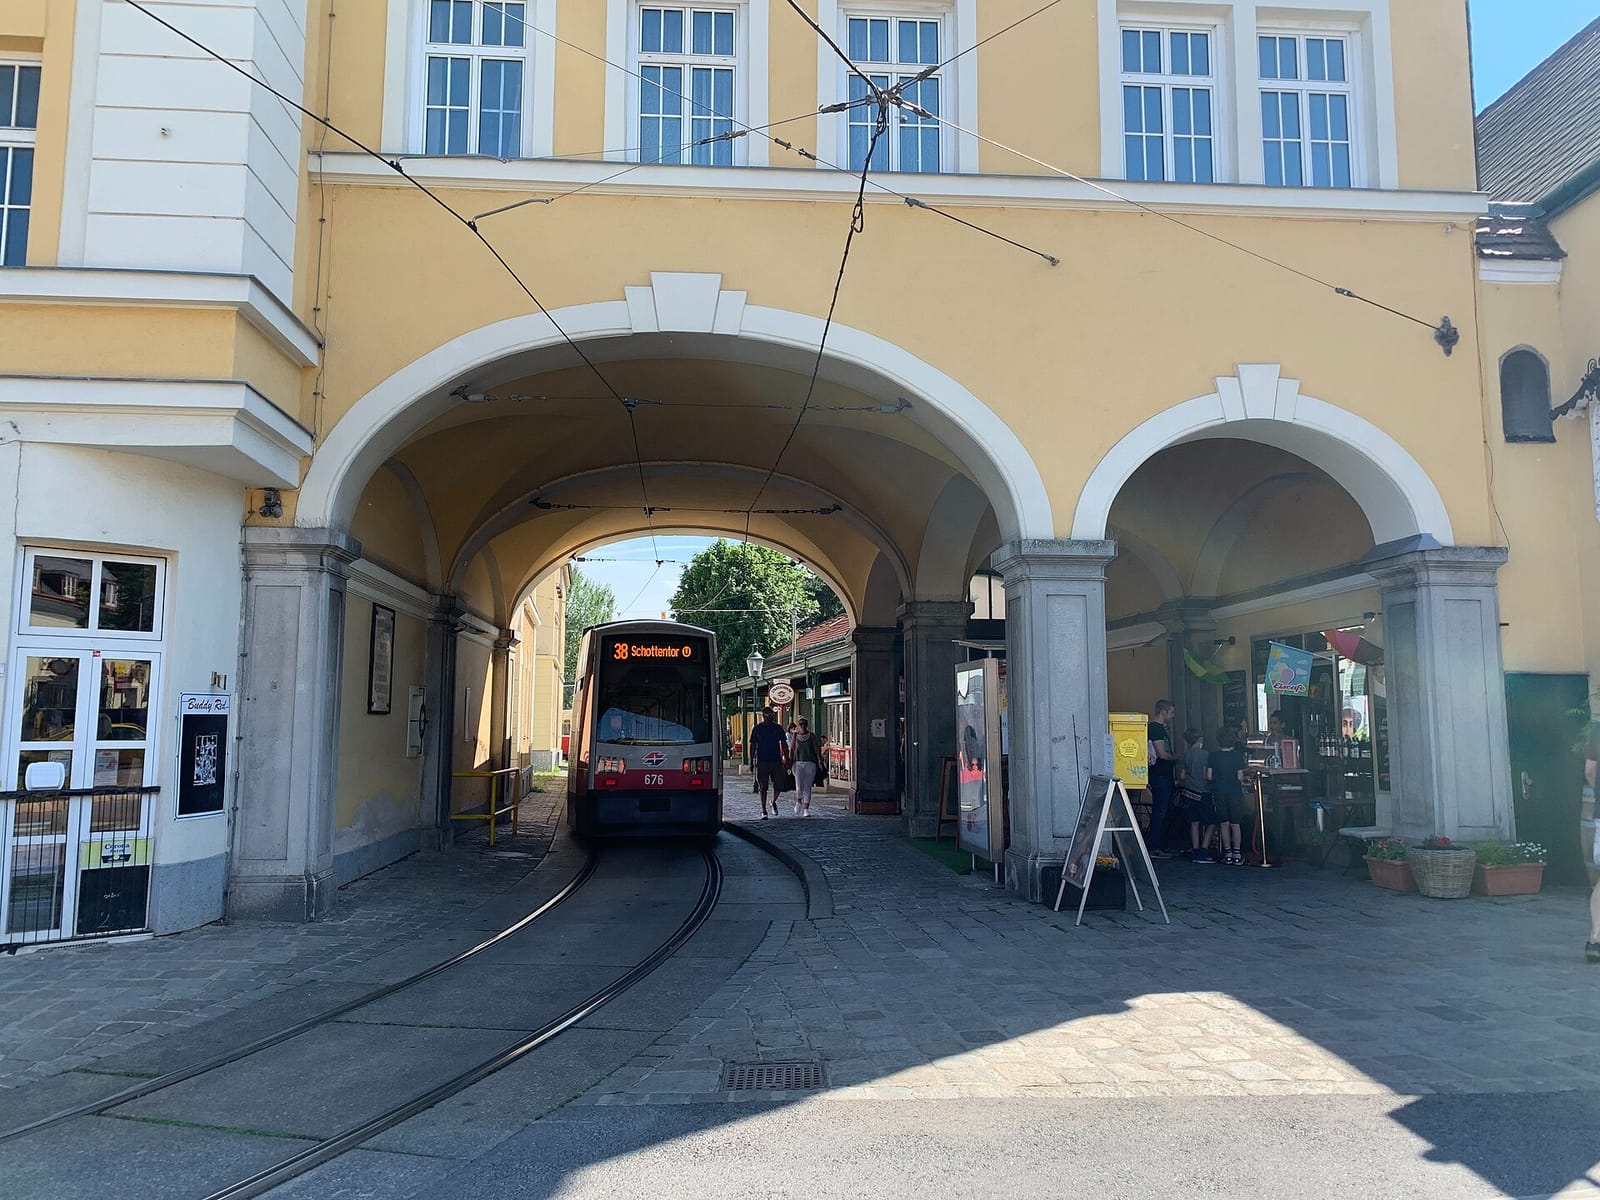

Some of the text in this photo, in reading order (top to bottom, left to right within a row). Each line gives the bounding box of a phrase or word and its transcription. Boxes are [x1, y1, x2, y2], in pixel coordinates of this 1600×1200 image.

[614, 643, 628, 659] 38
[631, 645, 679, 657] Schottentor
[187, 697, 212, 712] Buddy
[644, 774, 663, 785] 676
